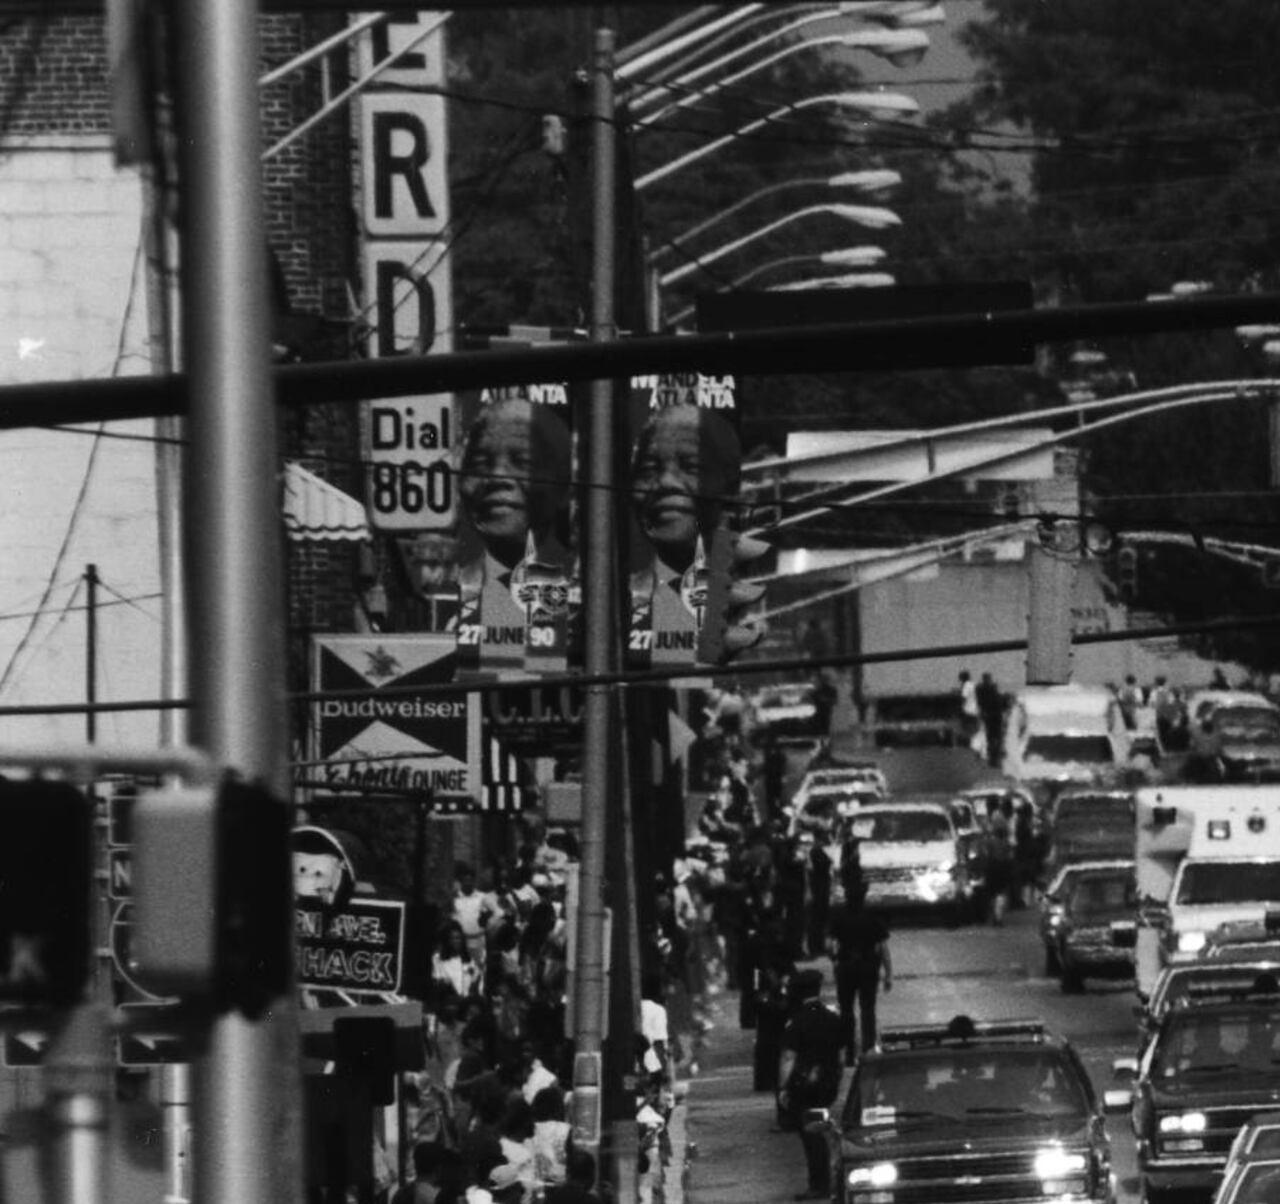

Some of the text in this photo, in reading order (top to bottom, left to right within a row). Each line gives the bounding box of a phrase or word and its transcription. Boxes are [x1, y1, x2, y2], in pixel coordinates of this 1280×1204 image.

[481, 383, 567, 406] ATLANTA
[650, 388, 736, 409] ATLANTA
[371, 407, 450, 450] Dial
[373, 461, 450, 515] 860
[459, 624, 555, 647] 27 JUNE 90
[629, 629, 696, 650] 27 JUNE
[296, 946, 394, 984] HACK
